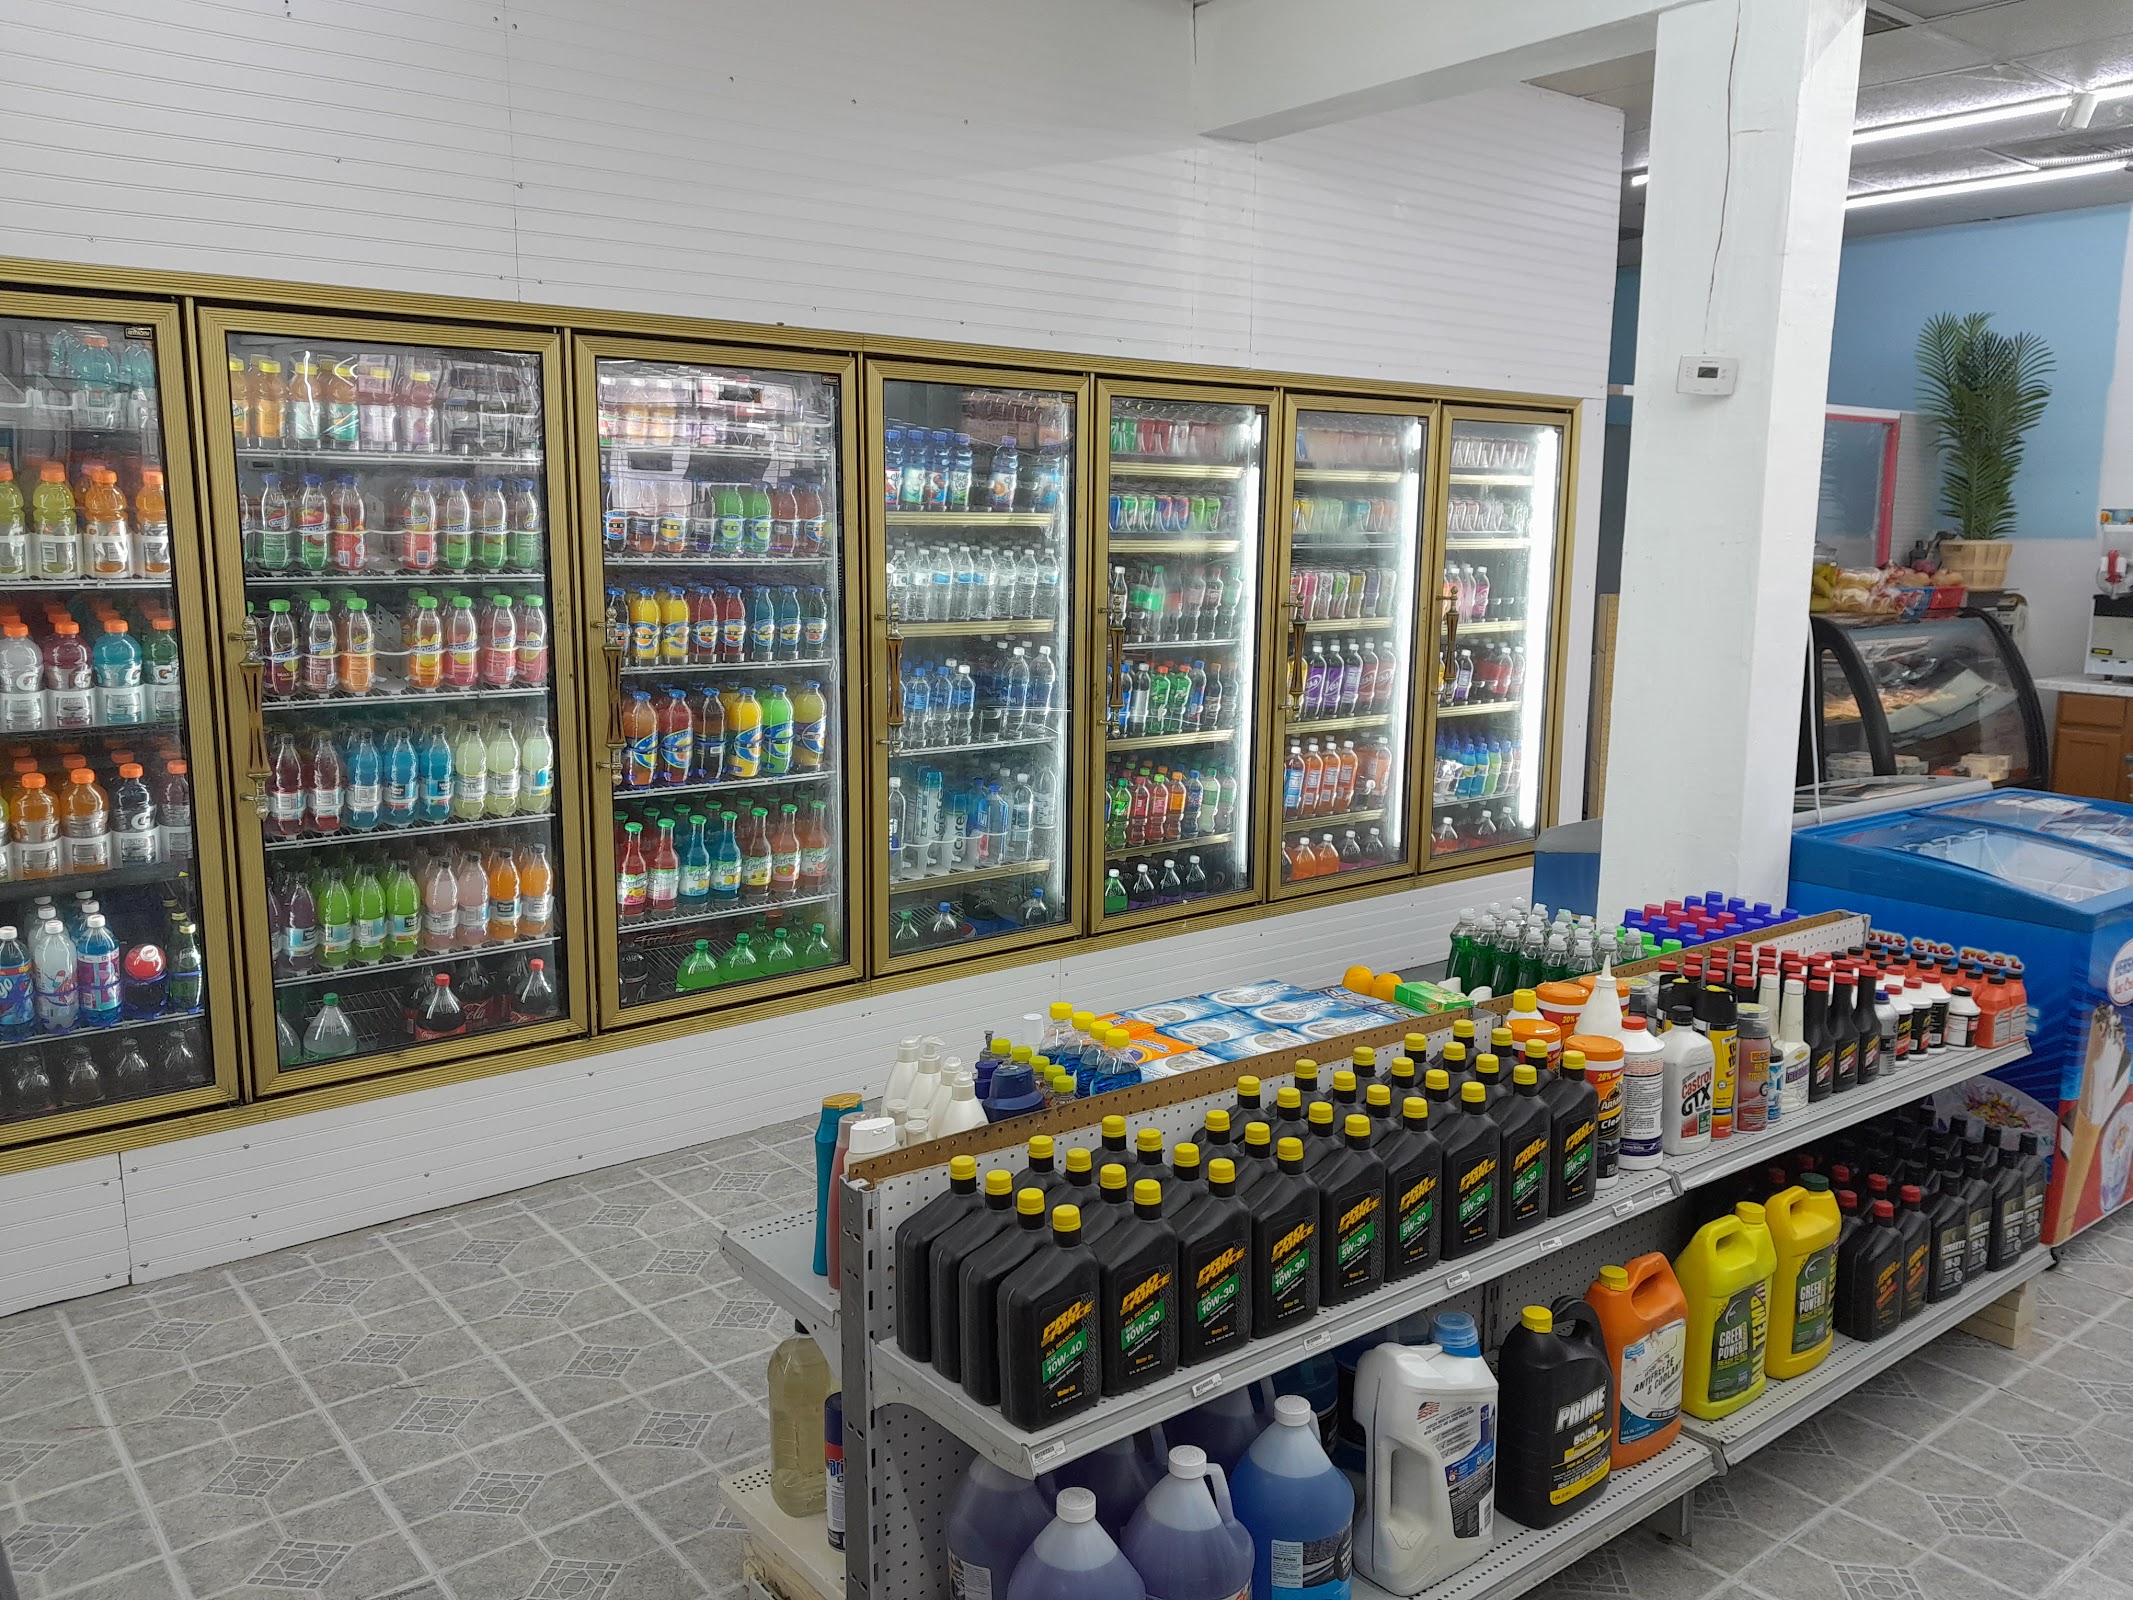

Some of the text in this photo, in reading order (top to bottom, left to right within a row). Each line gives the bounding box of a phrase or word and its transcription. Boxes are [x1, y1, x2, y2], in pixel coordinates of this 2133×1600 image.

[1913, 939, 1956, 957] the
[1961, 948, 2022, 971] real
[1597, 1072, 1612, 1082] 20%
[1682, 1067, 1712, 1099] Castrol
[1682, 1082, 1711, 1117] GTX
[1338, 1197, 1381, 1234] FORCE
[1340, 1197, 1371, 1230] PRO
[1271, 1222, 1316, 1263] FORCE
[1273, 1222, 1305, 1257] PRO
[1342, 1234, 1366, 1258] 5W-30
[1196, 1247, 1246, 1289] FORCE
[1198, 1247, 1235, 1281] PRO
[1275, 1258, 1305, 1288] 10W-30
[1120, 1272, 1172, 1317] FORCE
[1122, 1272, 1160, 1309] PRO
[1202, 1284, 1235, 1315] 10W-30
[1799, 1295, 1820, 1314] POWER
[1800, 1280, 1821, 1301] GREEN
[1041, 1300, 1095, 1348] FORCE
[1043, 1301, 1082, 1339] PRO
[1125, 1310, 1160, 1343] 10W-30
[1720, 1326, 1743, 1347] GREEN
[1047, 1340, 1082, 1375] 10W-40
[1718, 1340, 1743, 1360] POWER
[1556, 1384, 1606, 1434] PRIME
[1573, 1424, 1598, 1446] 50/50
